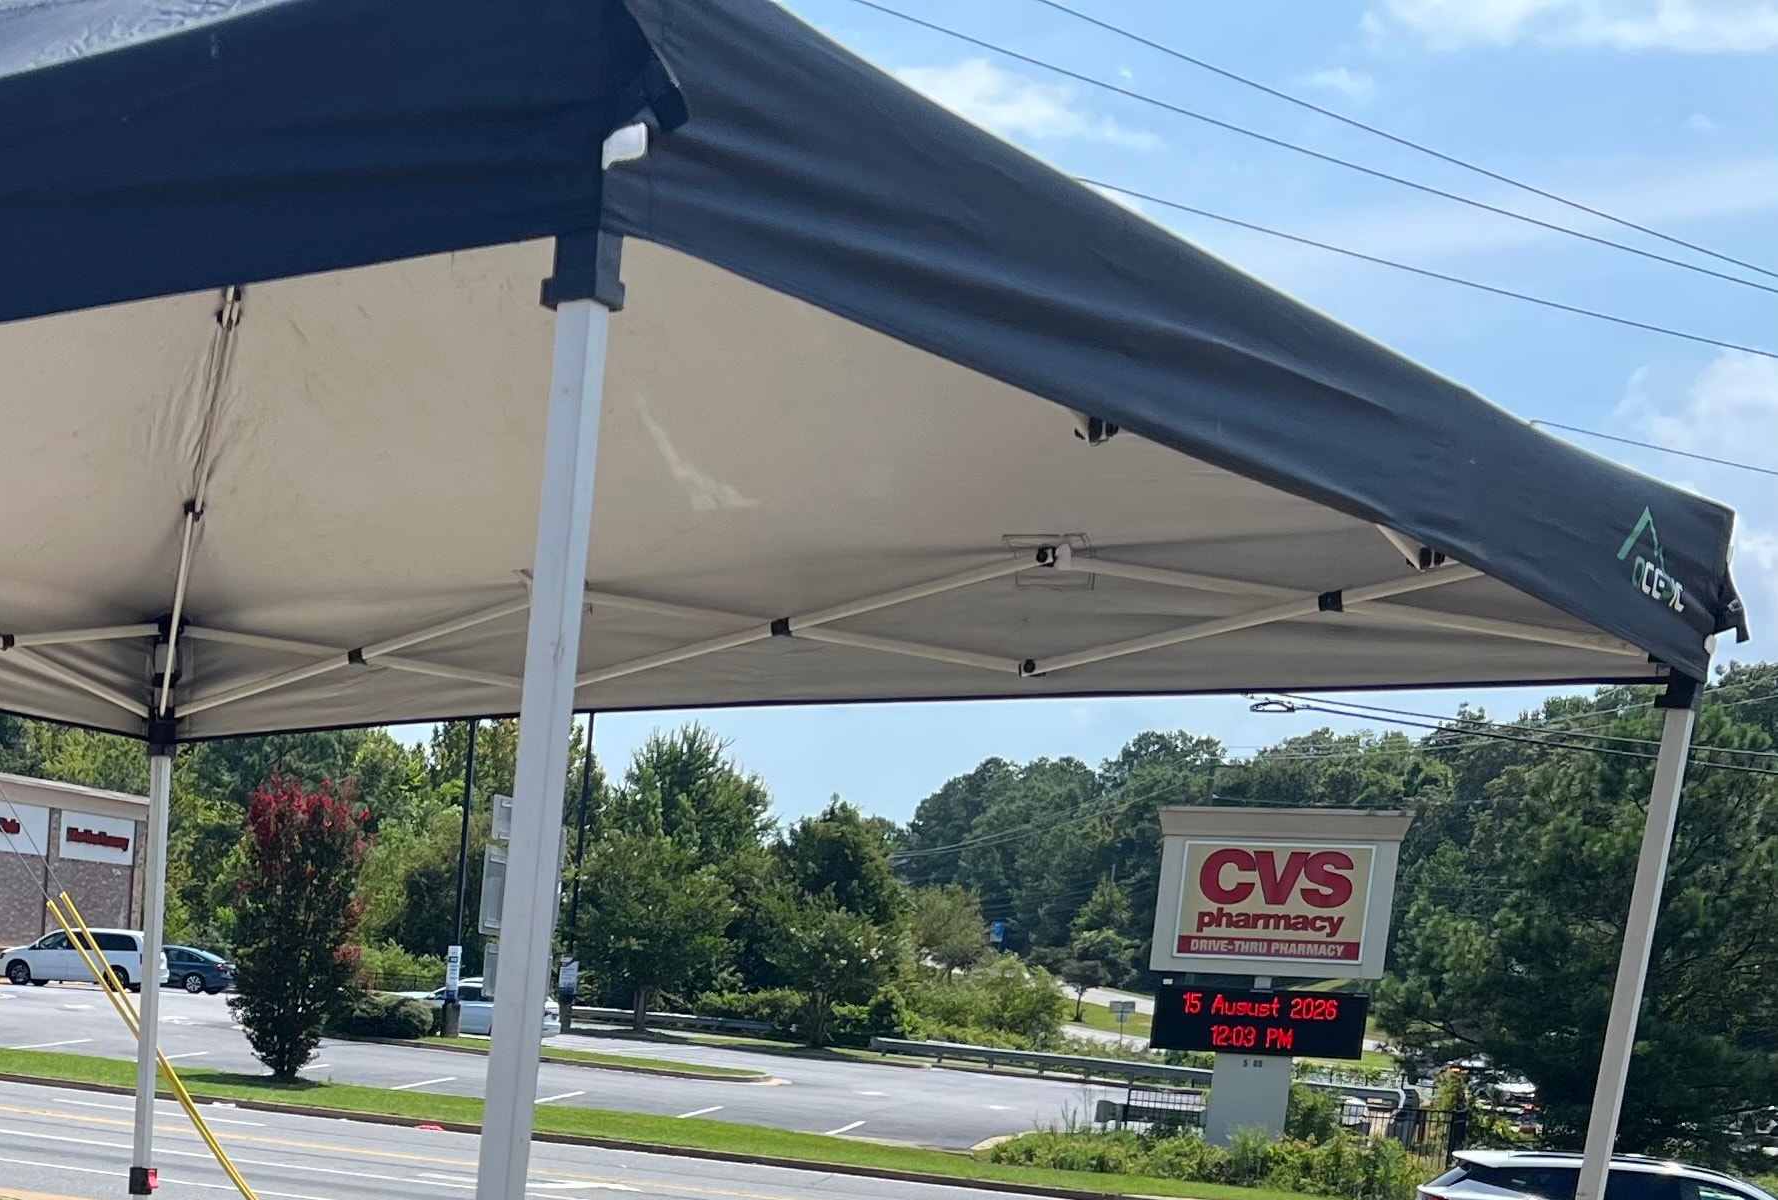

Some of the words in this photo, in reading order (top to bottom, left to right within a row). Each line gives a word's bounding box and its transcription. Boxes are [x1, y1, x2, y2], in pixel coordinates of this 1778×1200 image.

[1199, 848, 1354, 908] CVS
[1196, 907, 1345, 937] pharmacy
[1190, 939, 1267, 953] DRIVE-THRU
[1271, 942, 1344, 957] PHARMACY
[1183, 991, 1202, 1014] 15
[1211, 993, 1280, 1018] August
[1290, 998, 1338, 1020] 2026
[1210, 1025, 1256, 1048] 12:03
[1265, 1028, 1293, 1049] PM
